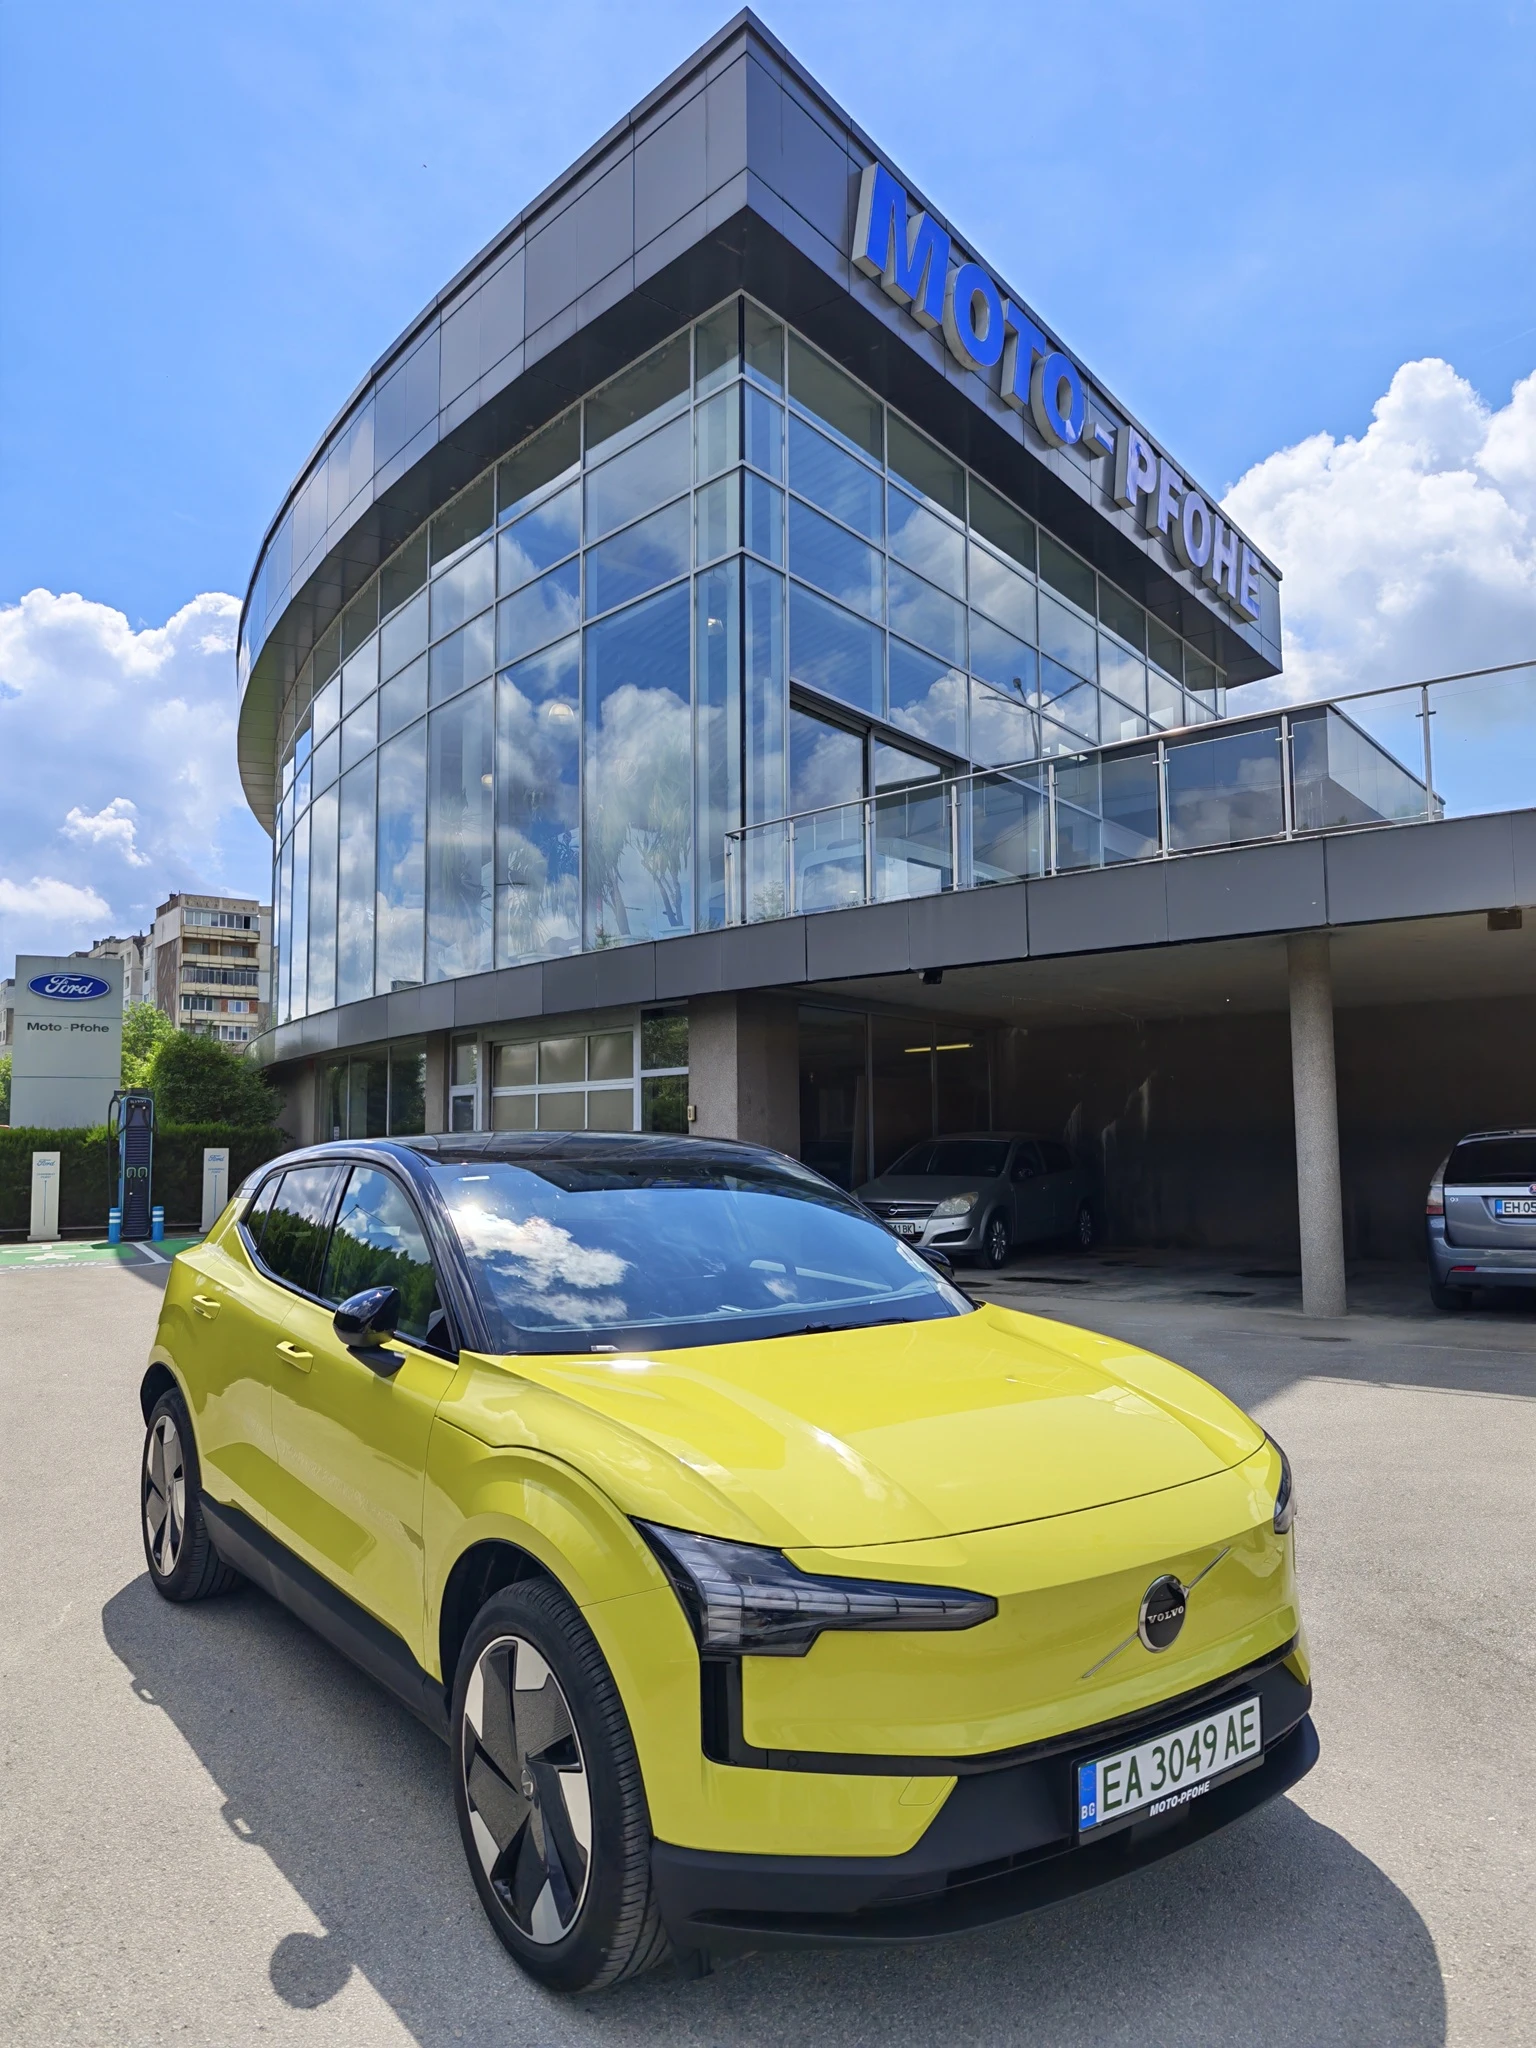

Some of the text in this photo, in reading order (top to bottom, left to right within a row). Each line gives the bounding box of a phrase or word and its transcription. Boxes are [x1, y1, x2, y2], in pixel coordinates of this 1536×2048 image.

[851, 161, 1262, 622] MOTO-PFOHE
[44, 975, 94, 995] Ford
[1504, 1201, 1521, 1213] EH
[902, 1225, 912, 1233] BK
[1147, 1605, 1184, 1624] VOLVO
[1103, 1705, 1256, 1813] EA 3049 AE
[1149, 1780, 1211, 1817] MOTO-PFOHE
[1081, 1801, 1096, 1821] BG
